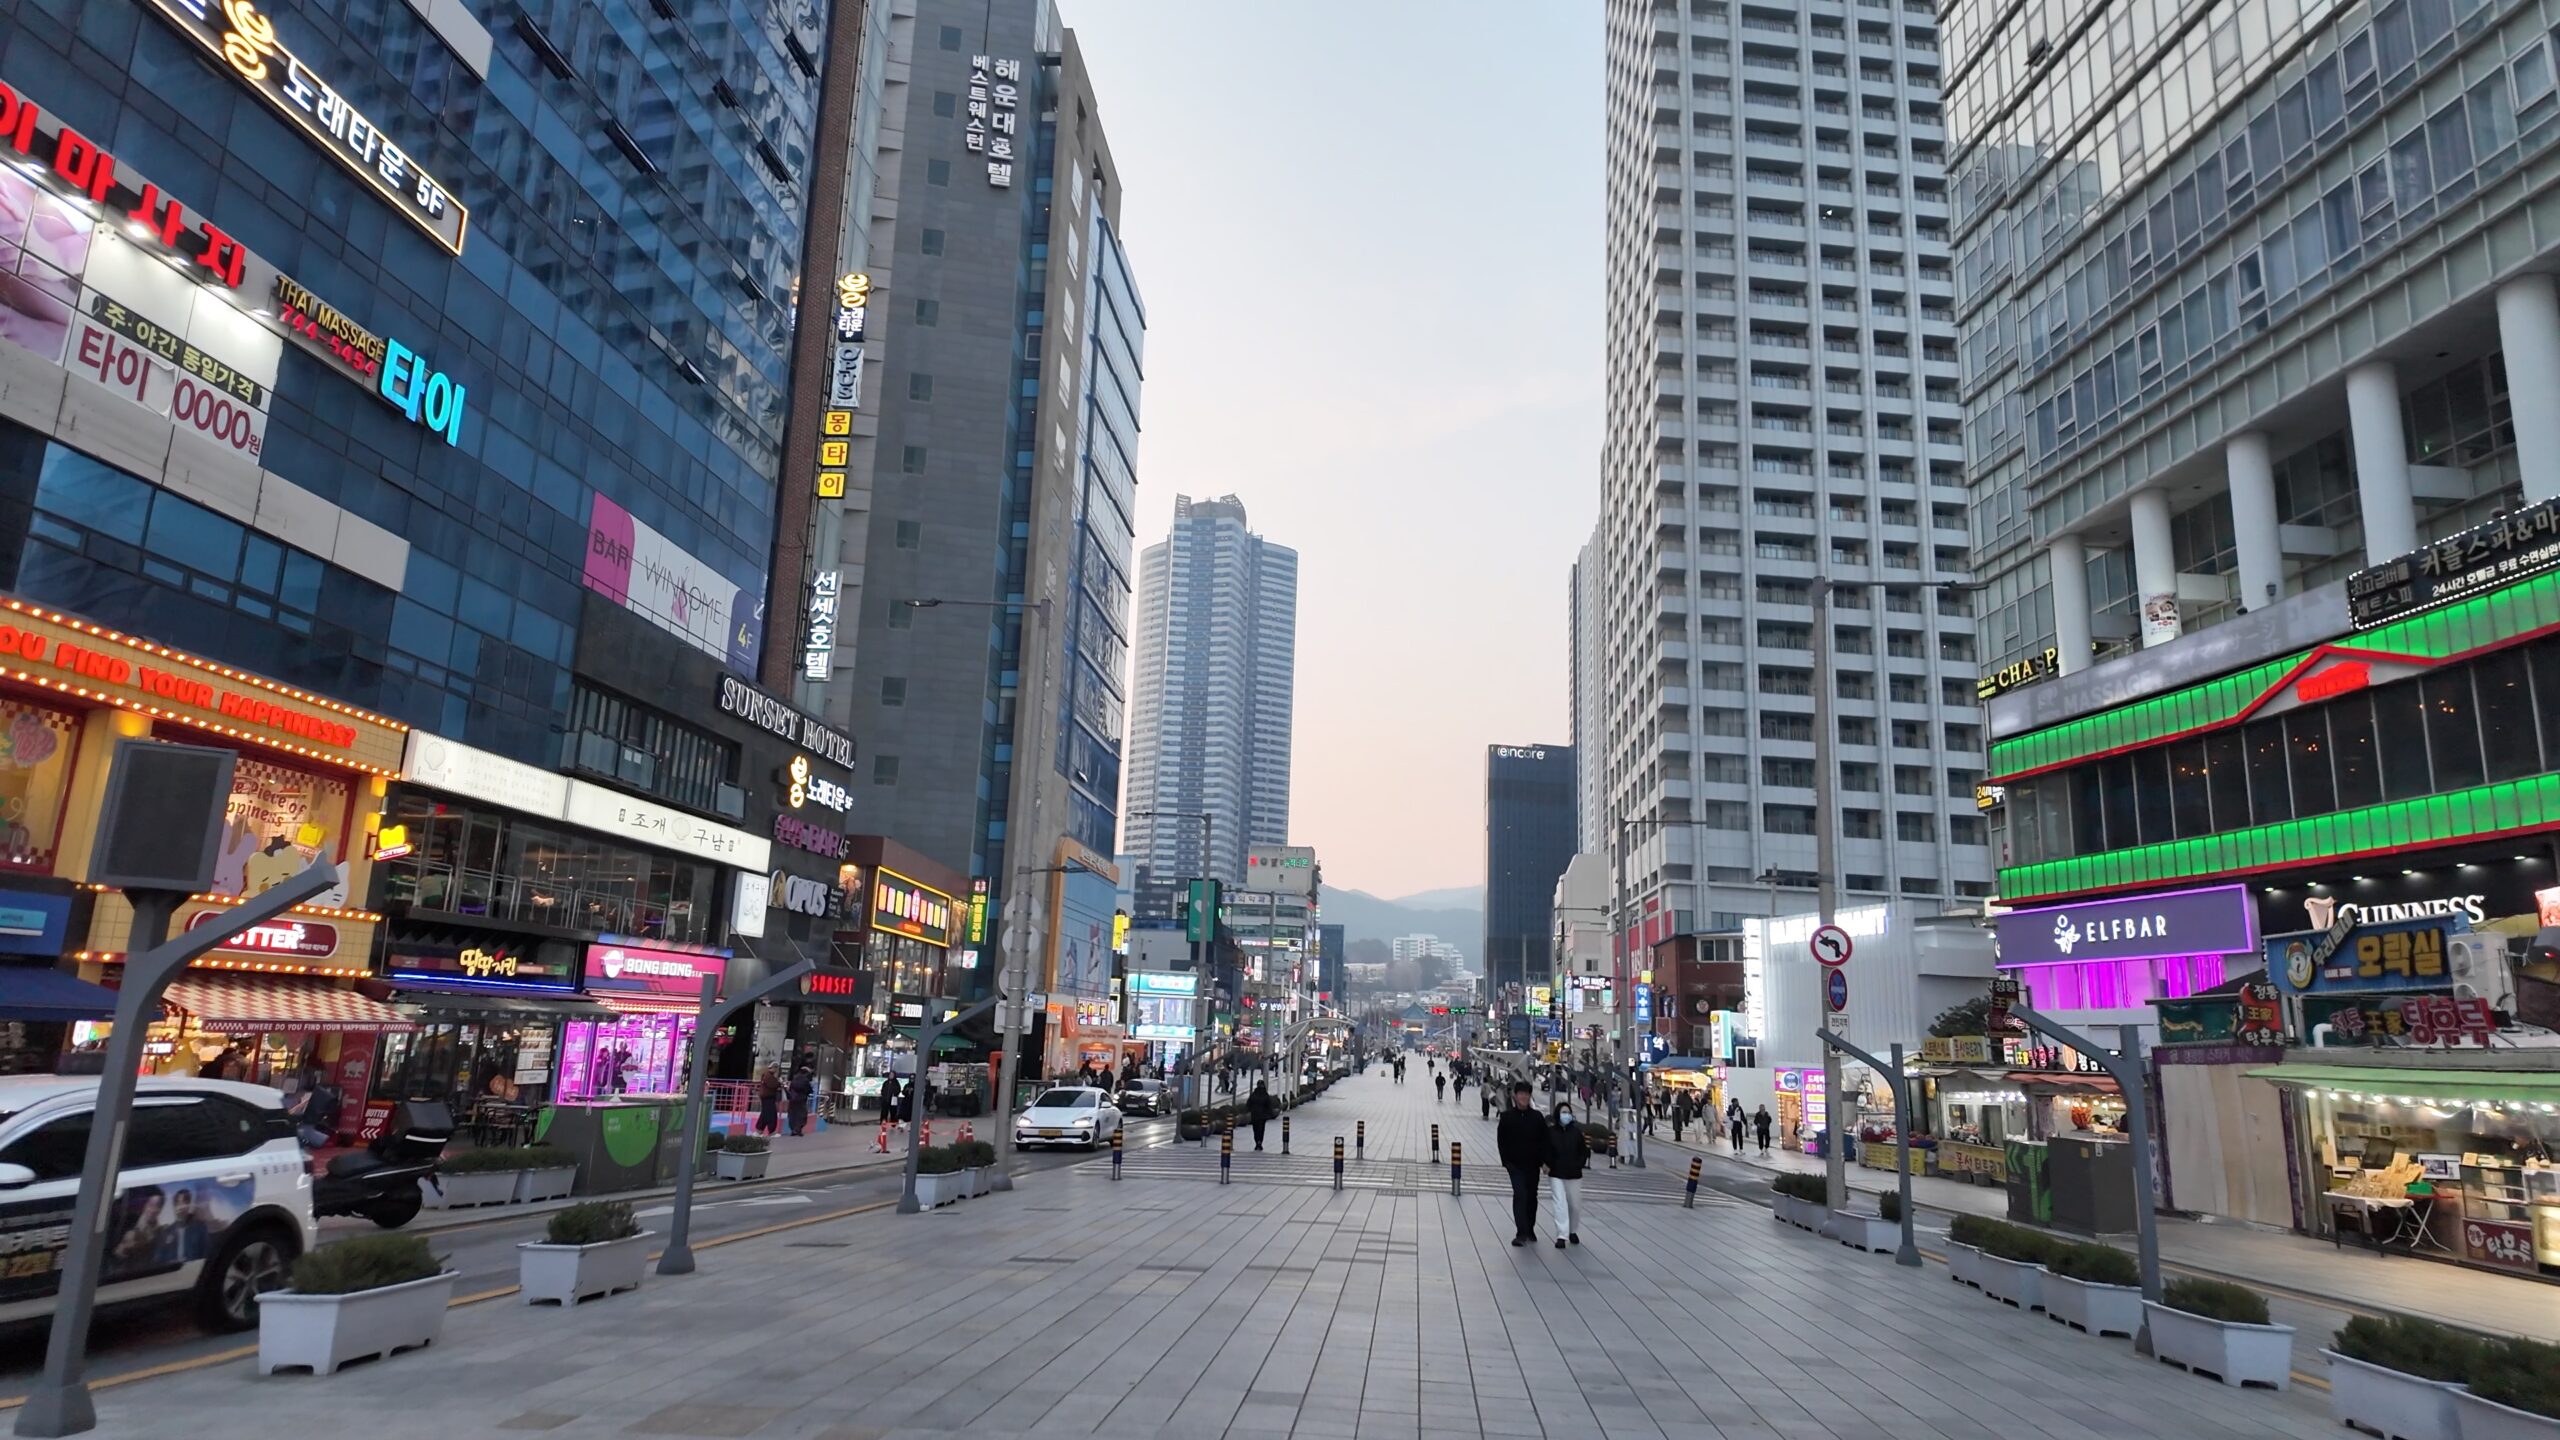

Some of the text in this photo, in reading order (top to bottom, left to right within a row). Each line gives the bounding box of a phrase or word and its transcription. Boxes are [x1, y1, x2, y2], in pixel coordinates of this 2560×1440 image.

[966, 55, 990, 151] 베스트웨스턴
[284, 56, 407, 189] 노래타운
[416, 176, 445, 217] 5F
[988, 60, 1020, 187] 해운대호텔
[279, 277, 386, 363] THAI MASSAGE
[79, 326, 150, 402] 타이
[379, 337, 466, 446] 타이
[592, 529, 722, 626] BAR WINSOME
[2432, 577, 2464, 597] 24시간
[2499, 559, 2518, 573] 무료
[737, 622, 753, 650] 4F
[806, 571, 838, 678] 선셋호텔
[55, 643, 130, 685] FIND
[139, 665, 215, 709] YOUR
[220, 691, 358, 749] HAPPINESS?
[722, 676, 855, 770] SUNSET HOTEL
[288, 799, 308, 821] of
[631, 813, 726, 851] 조개 구남
[786, 874, 829, 917] OPUS
[2337, 894, 2485, 925] GUINNESS
[2086, 914, 2168, 943] ELFBAR
[460, 948, 517, 977] 땅땅치킨
[624, 957, 660, 975] BONG
[661, 960, 693, 978] BONG
[2356, 928, 2443, 977] 오락실
[811, 974, 855, 995] SUNSET
[2253, 984, 2279, 1000] 정통
[247, 1022, 273, 1030] WHERE
[288, 1023, 302, 1031] YOU
[304, 1023, 321, 1031] FIND
[322, 1023, 341, 1031] YOUR
[2245, 1027, 2285, 1047] 탕후루
[2402, 999, 2490, 1049] 탕후루
[365, 1108, 389, 1119] BUTTER
[366, 1117, 383, 1128] SHOP
[2487, 1229, 2532, 1263] 탕후루
